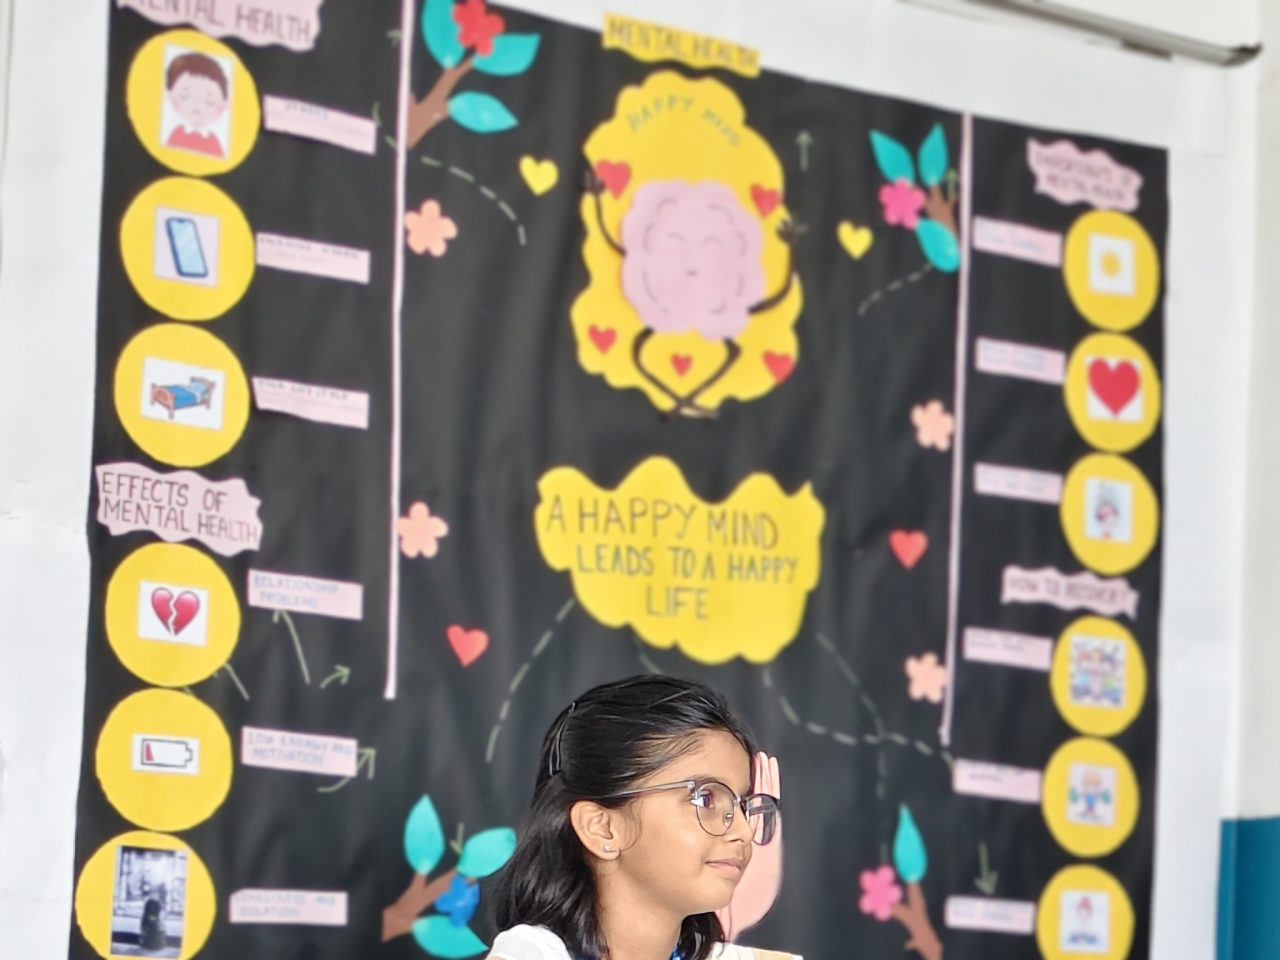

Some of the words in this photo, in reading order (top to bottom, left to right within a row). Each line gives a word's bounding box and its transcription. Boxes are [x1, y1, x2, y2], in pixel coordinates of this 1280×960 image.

[139, 0, 225, 27] NTAL
[235, 4, 311, 43] HEALTH
[608, 17, 683, 57] MENTAL
[626, 94, 694, 134] HAPPY
[101, 471, 190, 507] EFFECTS
[202, 488, 228, 514] OF
[103, 496, 192, 533] MENTAL
[197, 511, 259, 543] HEALTH
[546, 494, 567, 534] A
[578, 496, 697, 540] HAPPY
[707, 509, 779, 550] MIND
[576, 544, 655, 577] LEADS
[667, 545, 697, 580] TO
[701, 551, 716, 581] A
[727, 552, 798, 584] HAPPY
[645, 584, 710, 620] LIFE
